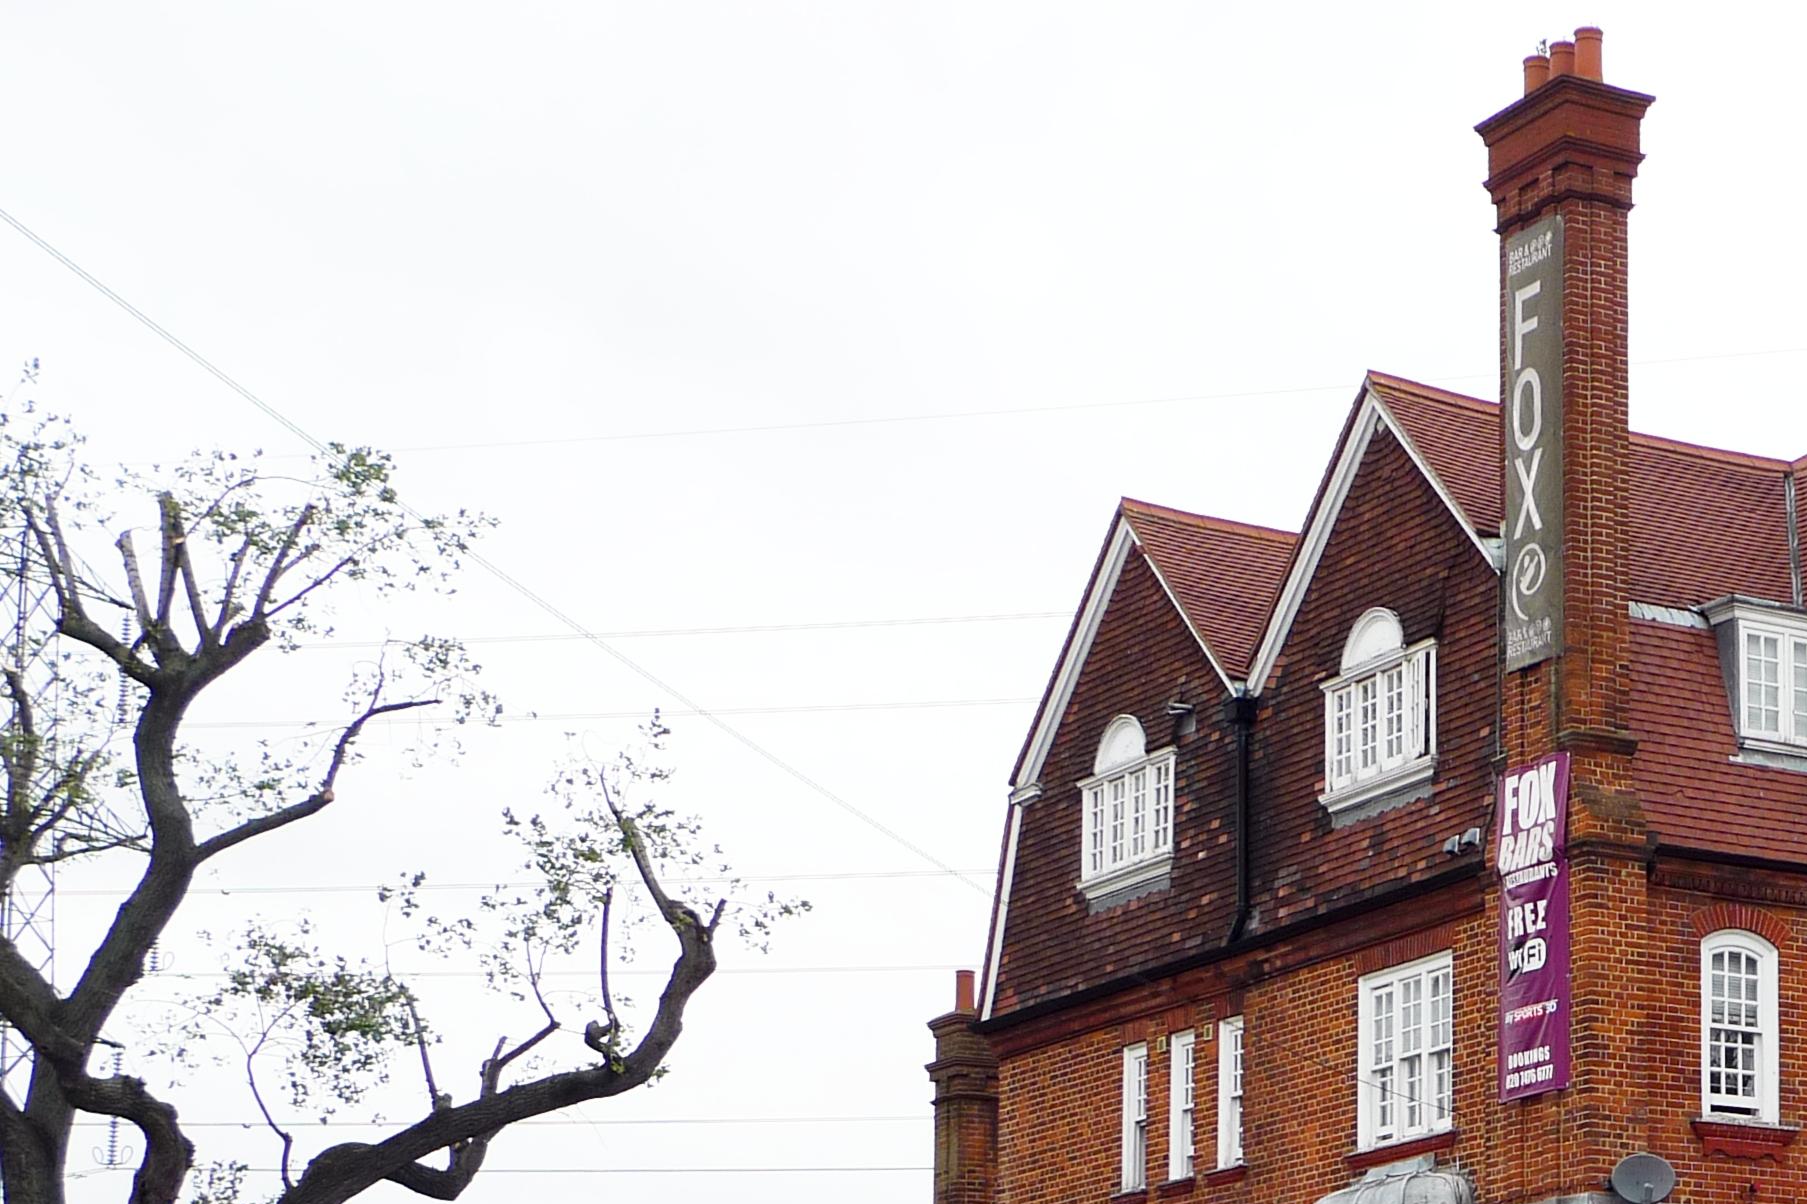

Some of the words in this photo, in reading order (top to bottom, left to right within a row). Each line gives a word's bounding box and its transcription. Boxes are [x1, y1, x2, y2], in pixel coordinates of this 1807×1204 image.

[1508, 243, 1553, 275] RESTAURANT
[1513, 279, 1543, 540] FOX
[1507, 630, 1552, 658] RESTAURANT
[1502, 761, 1557, 836] FOX
[1498, 820, 1555, 876] BARS
[1507, 899, 1548, 940] FREE
[1513, 1004, 1543, 1022] SPORTS
[1507, 1045, 1551, 1070] BOOKINGS
